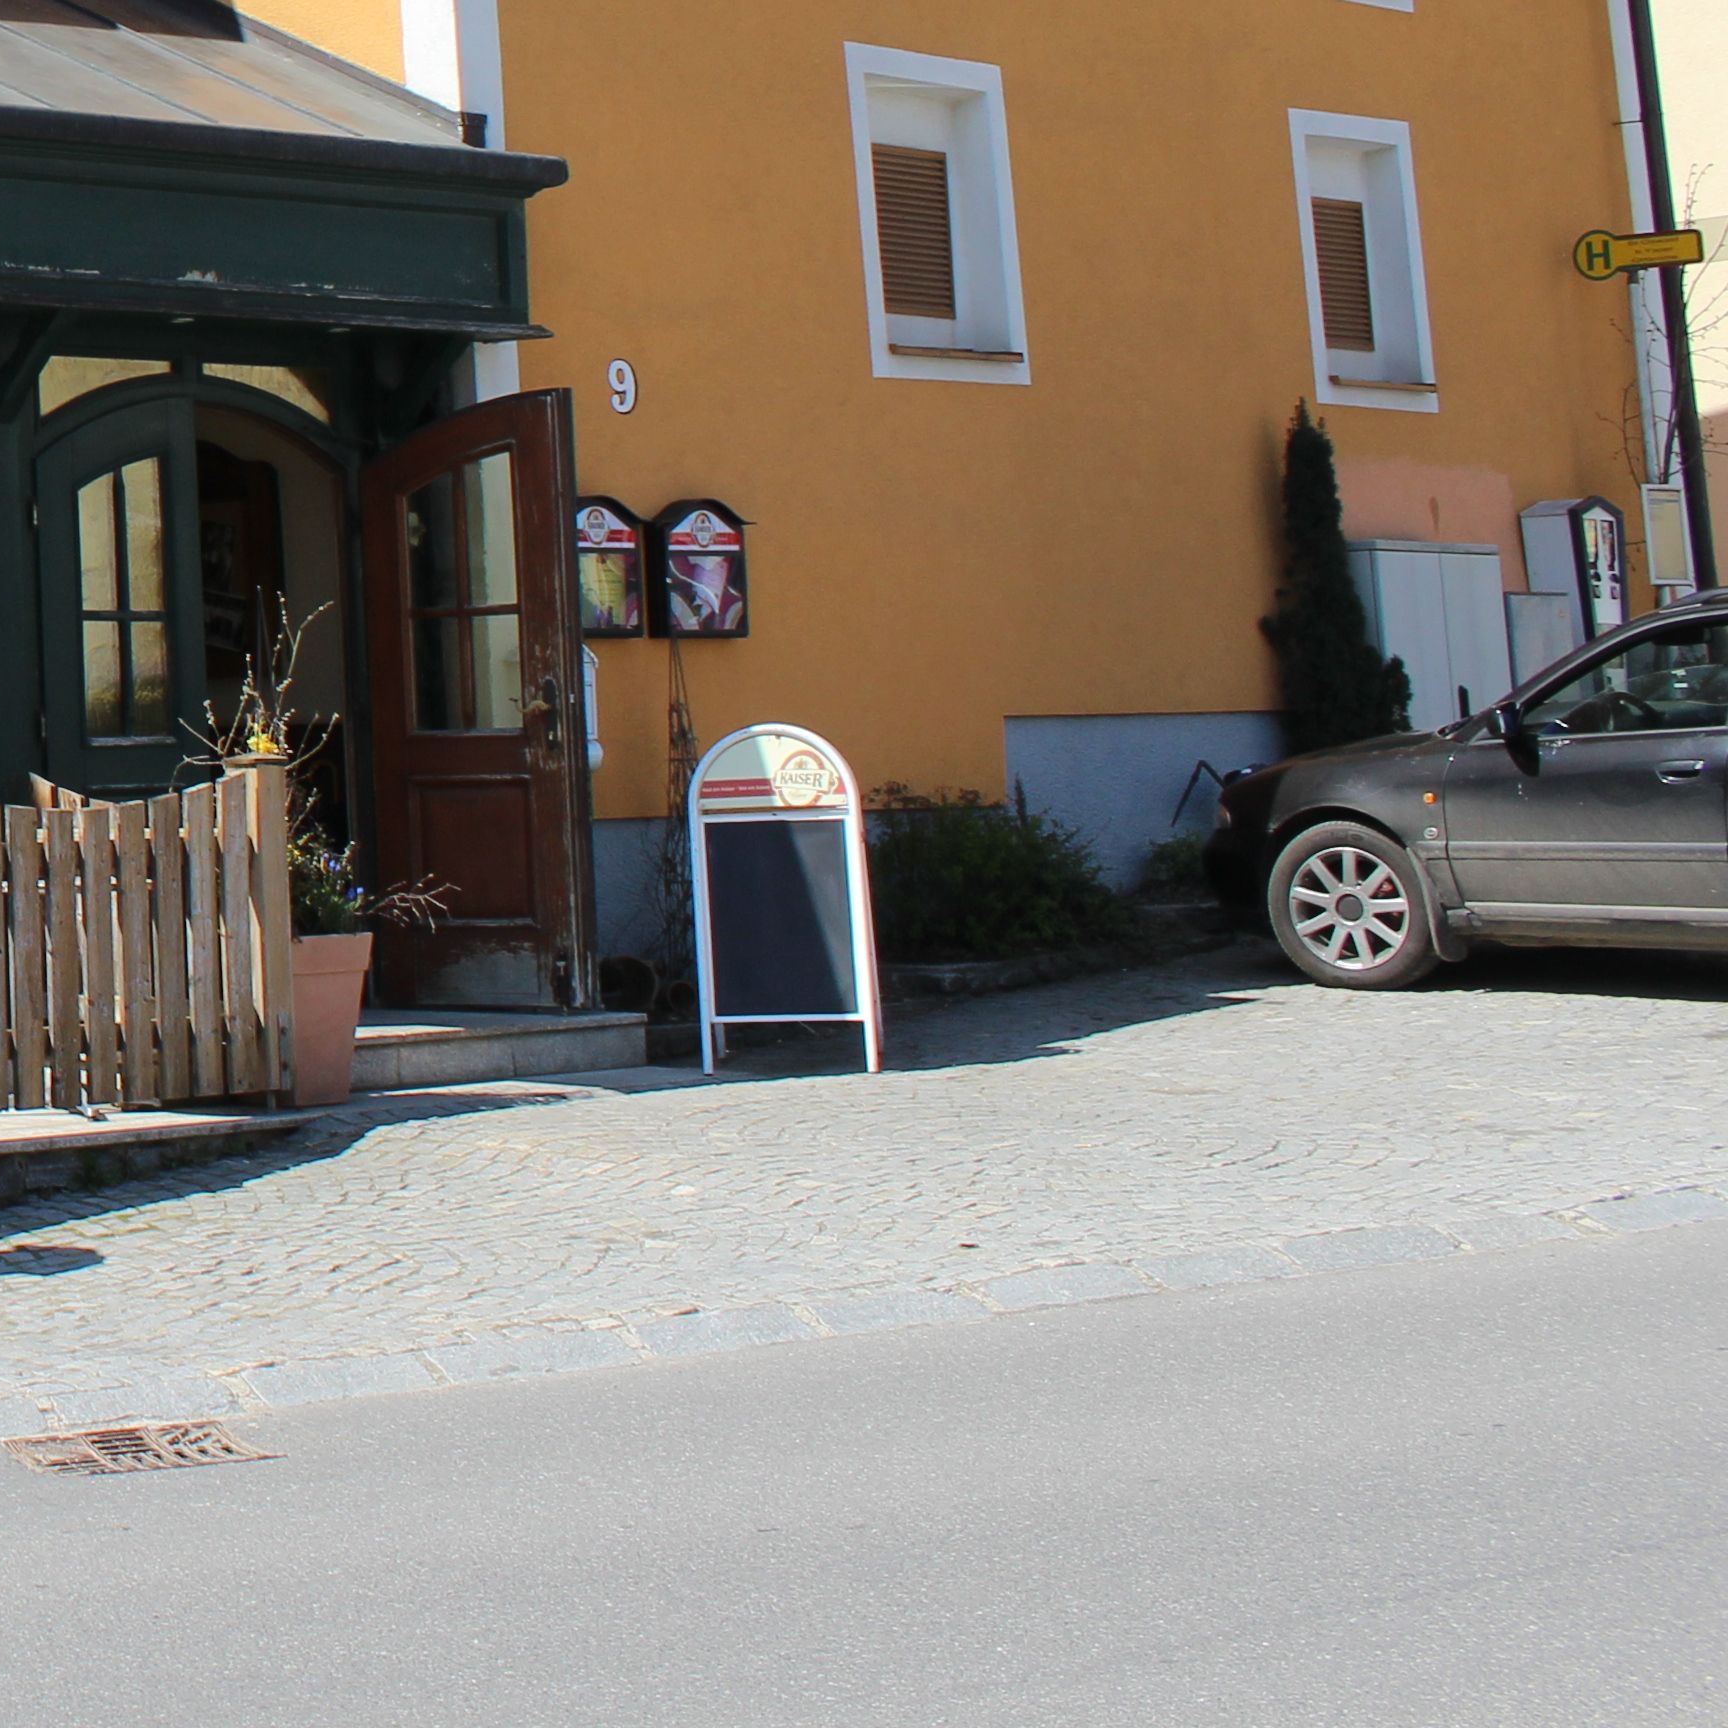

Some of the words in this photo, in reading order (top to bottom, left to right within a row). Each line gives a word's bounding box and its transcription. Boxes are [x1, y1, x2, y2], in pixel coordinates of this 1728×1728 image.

[1585, 239, 1611, 271] H
[607, 358, 638, 415] 9
[779, 772, 823, 788] KAISER
